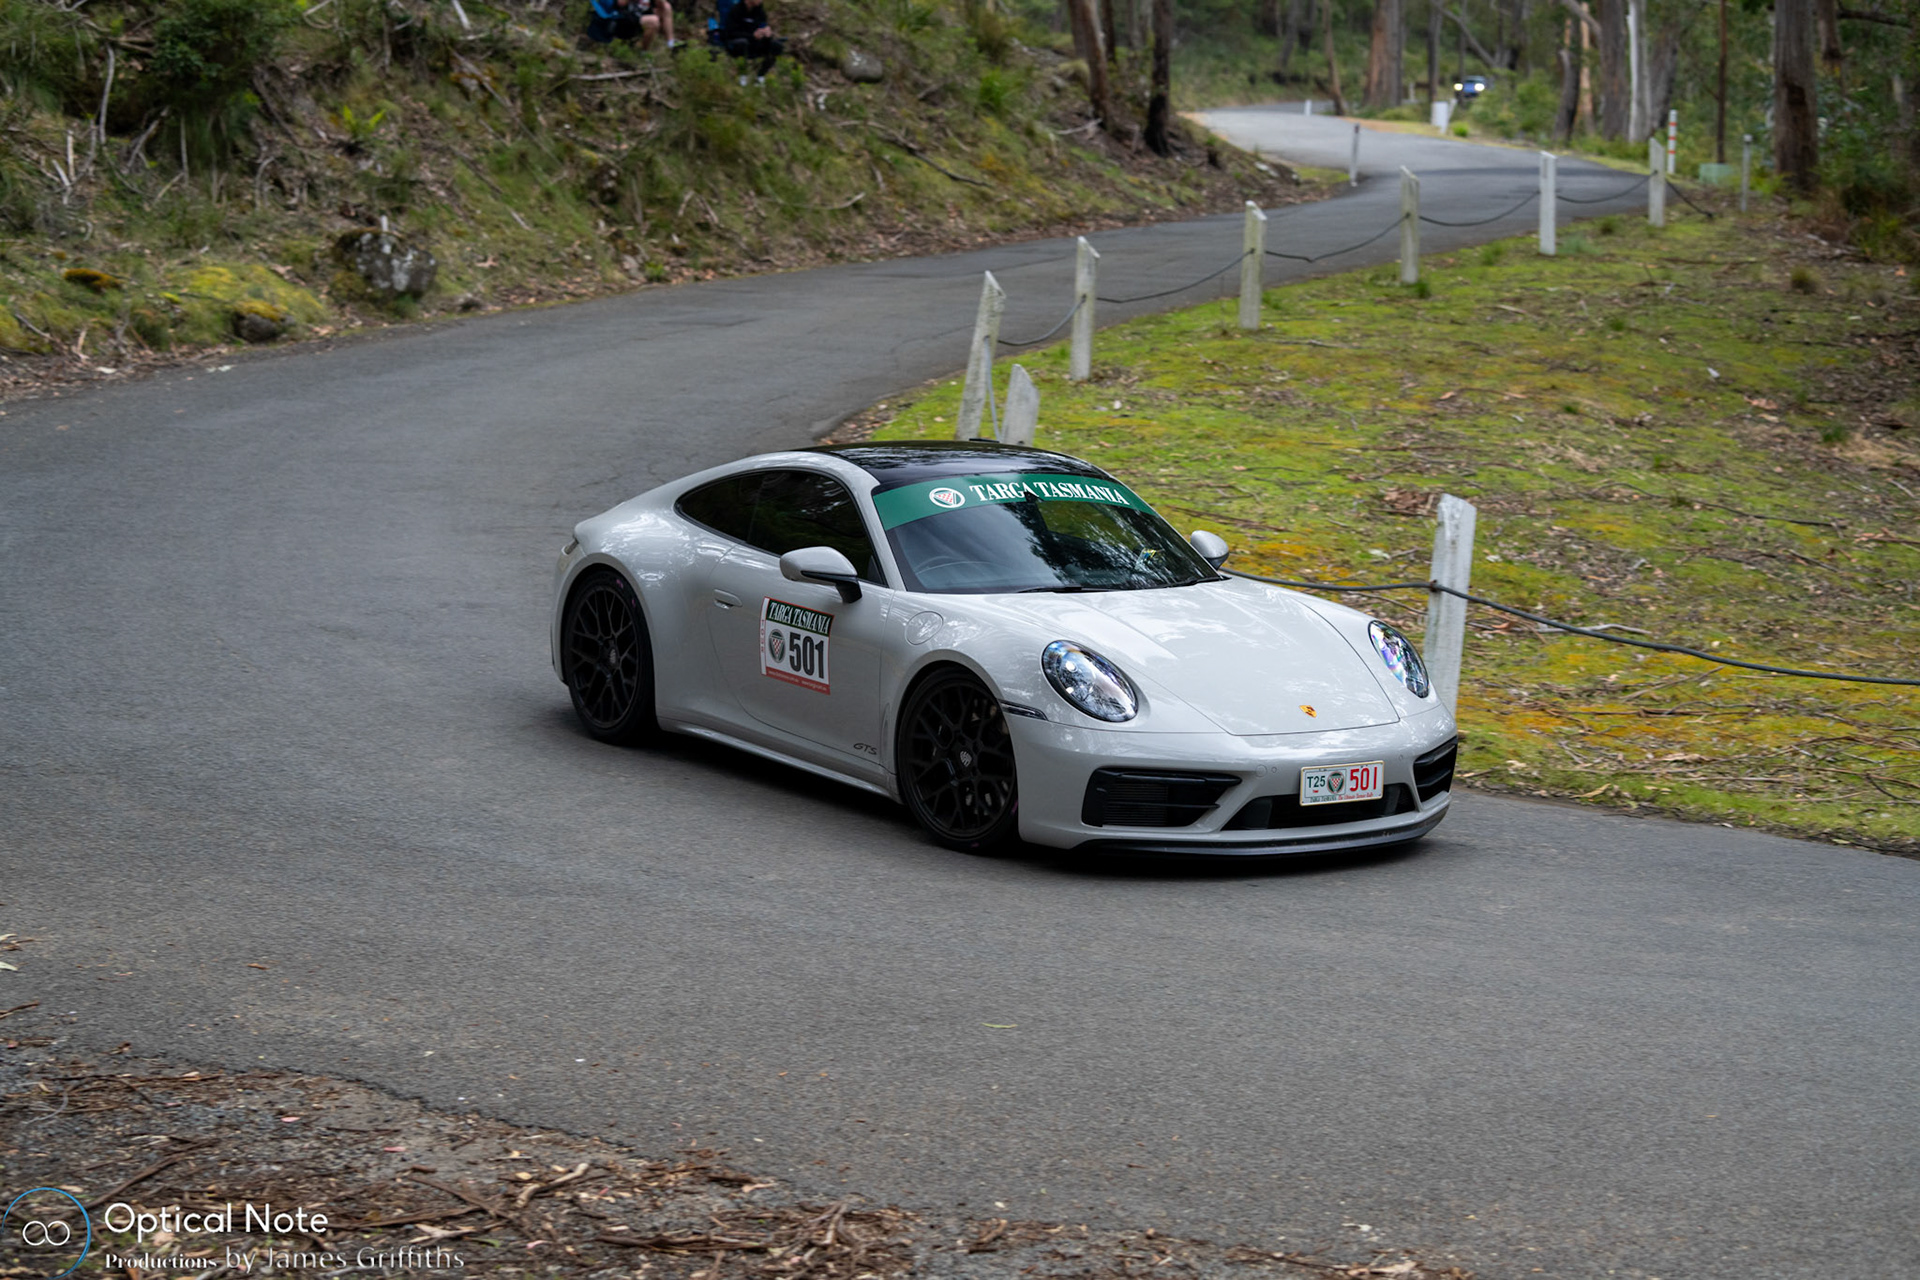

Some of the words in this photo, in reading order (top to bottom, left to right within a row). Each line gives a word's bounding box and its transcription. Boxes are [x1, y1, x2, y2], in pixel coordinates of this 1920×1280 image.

[969, 482, 1038, 501] TARGA
[1033, 481, 1130, 505] TASMANIA
[768, 602, 793, 625] TARGA
[792, 608, 831, 634] TASMANIA
[789, 631, 824, 679] 501
[853, 743, 877, 755] GTS
[1307, 775, 1326, 788] T25
[1350, 766, 1378, 792] 501
